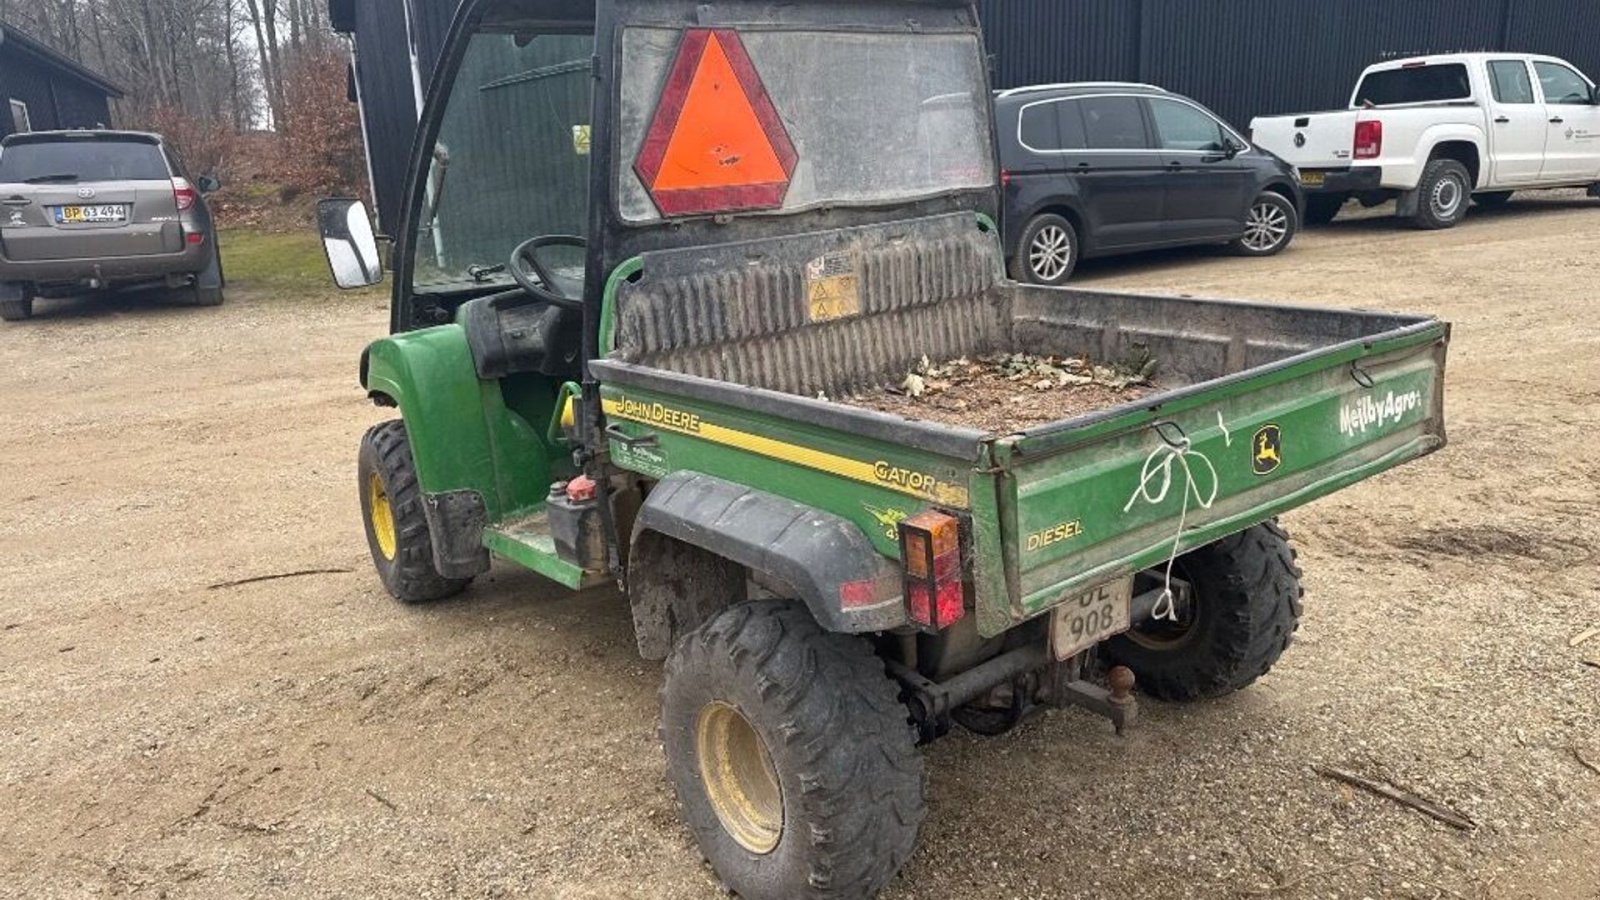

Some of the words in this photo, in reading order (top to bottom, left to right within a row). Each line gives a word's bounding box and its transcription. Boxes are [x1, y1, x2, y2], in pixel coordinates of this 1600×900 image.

[616, 395, 650, 420] JOHN
[652, 403, 699, 430] DEERE
[875, 460, 935, 492] GATOR
[1026, 519, 1082, 551] DIESEL
[1070, 604, 1114, 642] 908
